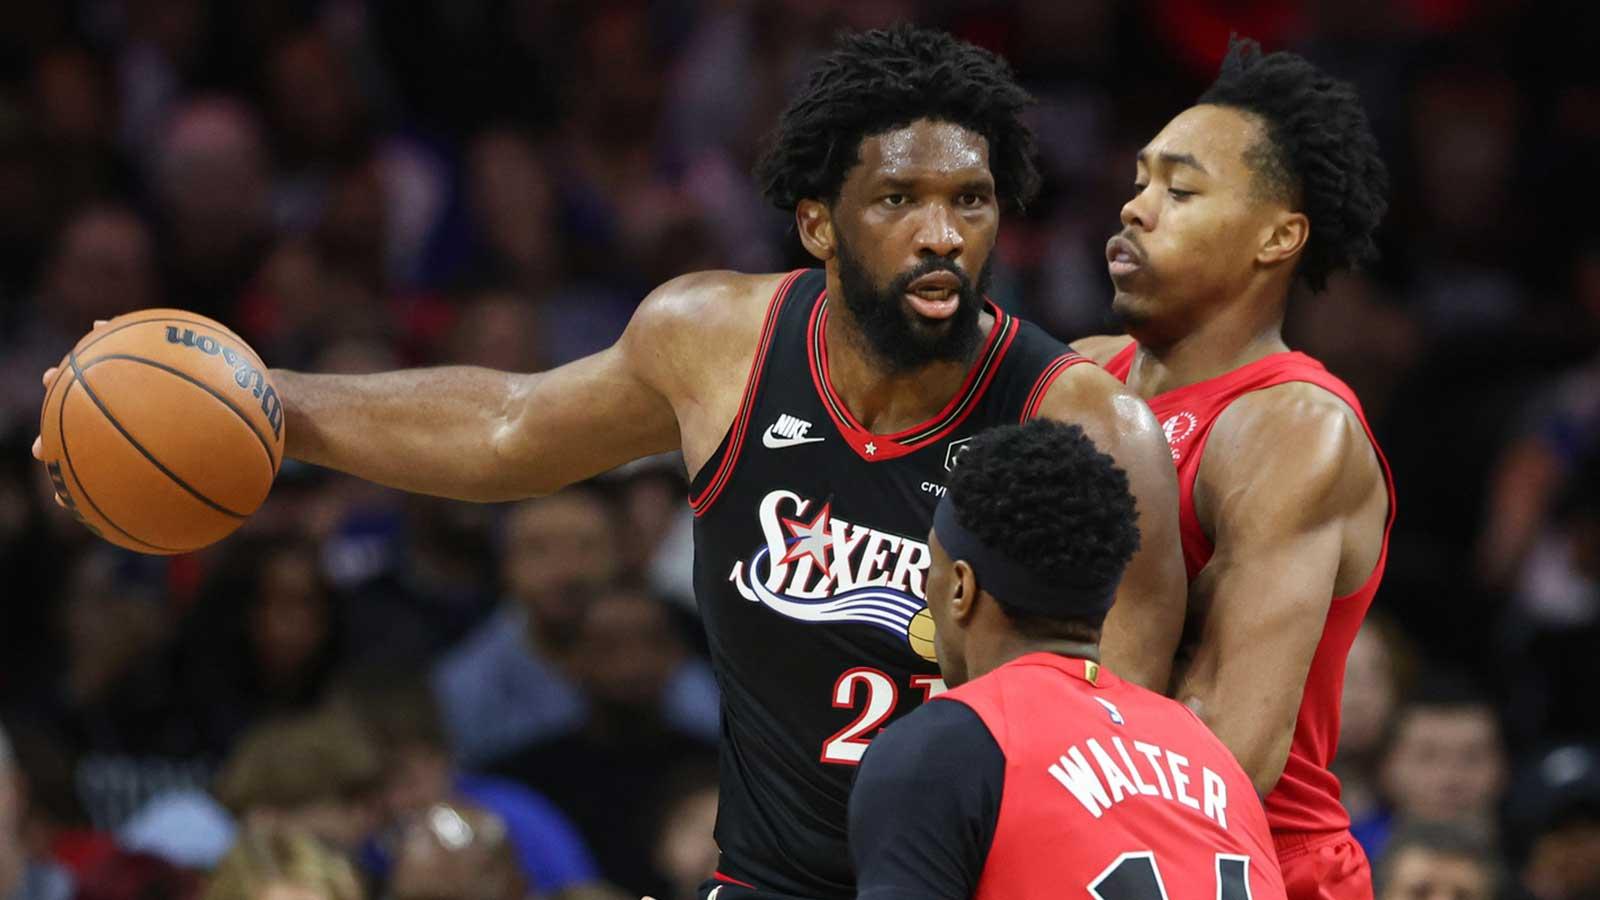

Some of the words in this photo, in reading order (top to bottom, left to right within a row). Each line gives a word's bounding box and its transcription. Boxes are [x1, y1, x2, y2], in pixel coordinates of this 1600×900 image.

[165, 326, 284, 442] Wilson
[772, 413, 813, 439] NIKE
[921, 481, 948, 498] cry
[729, 489, 932, 602] SIXER
[1048, 736, 1228, 830] WALTER
